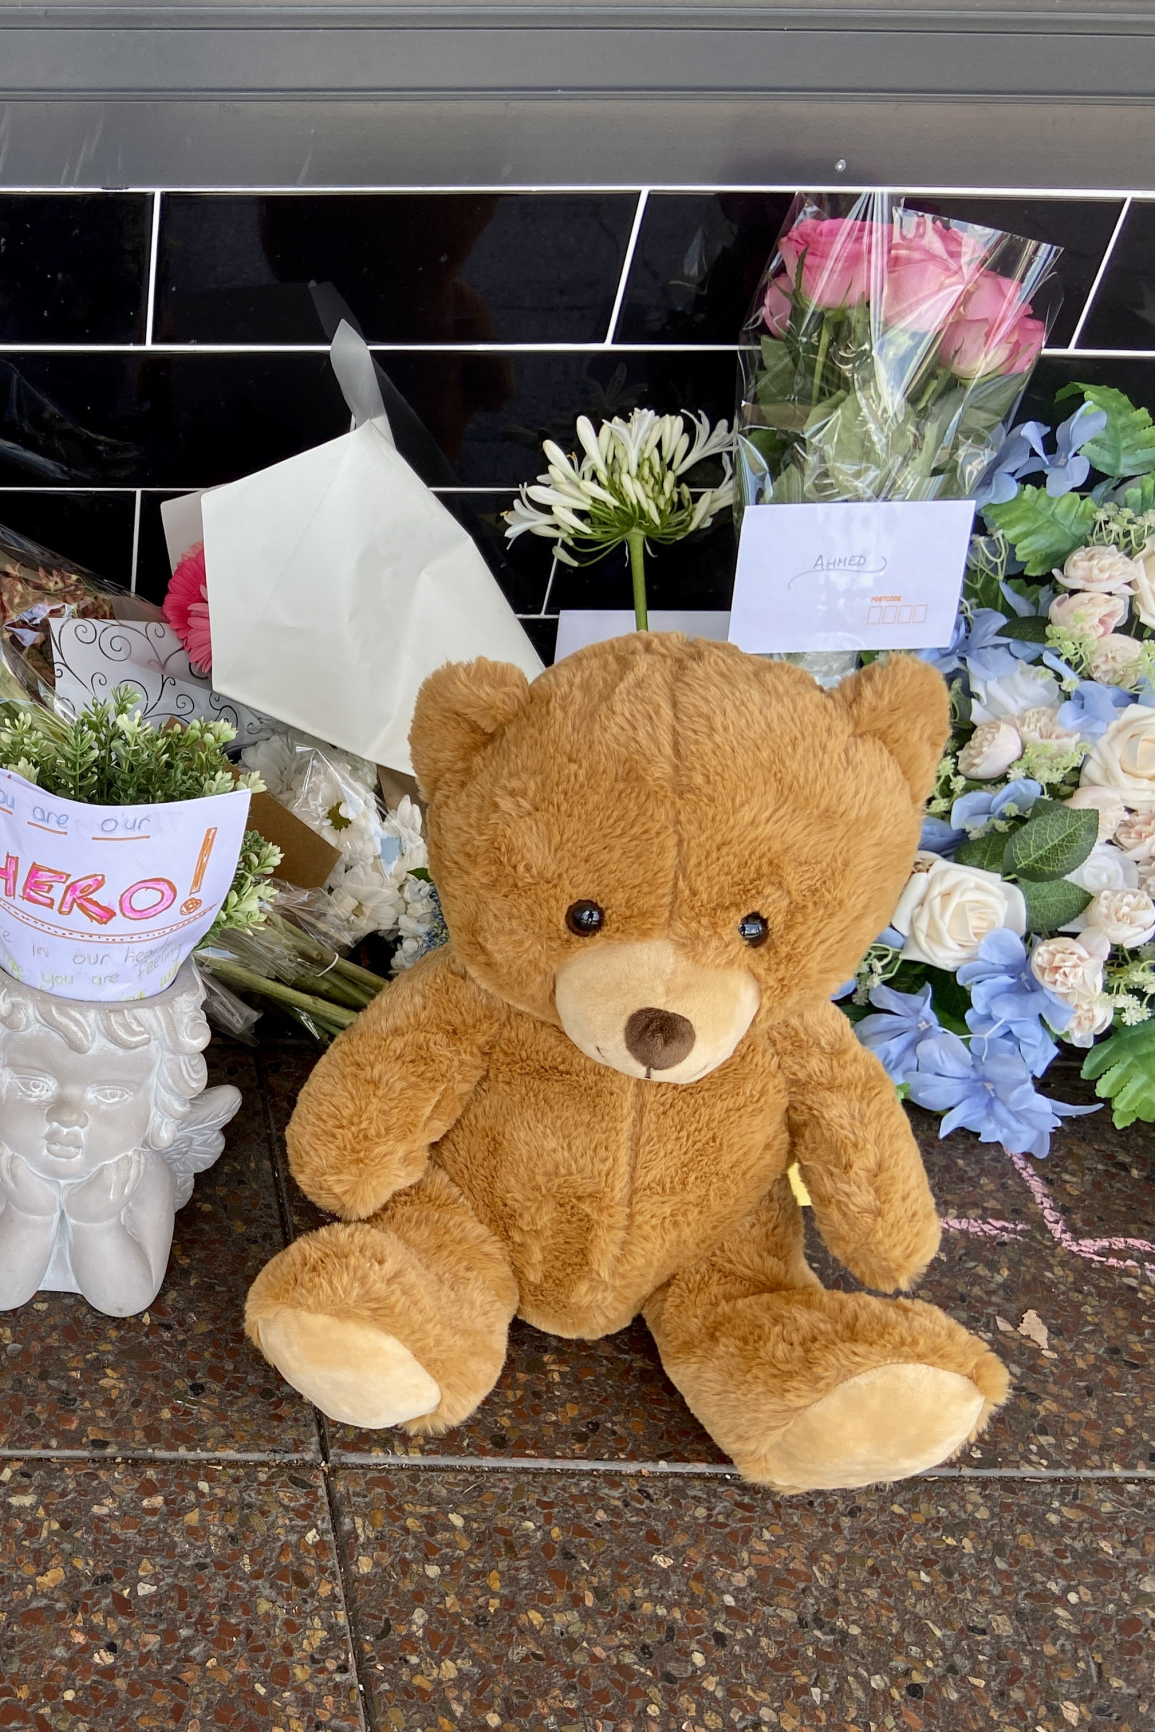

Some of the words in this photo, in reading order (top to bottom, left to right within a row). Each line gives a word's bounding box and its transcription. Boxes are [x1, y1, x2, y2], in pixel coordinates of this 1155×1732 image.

[812, 554, 867, 570] AHMED
[871, 595, 902, 603] POSTCODE
[32, 806, 69, 829] are
[100, 814, 151, 834] our
[72, 952, 110, 966] our
[41, 970, 73, 992] you
[91, 973, 119, 986] are
